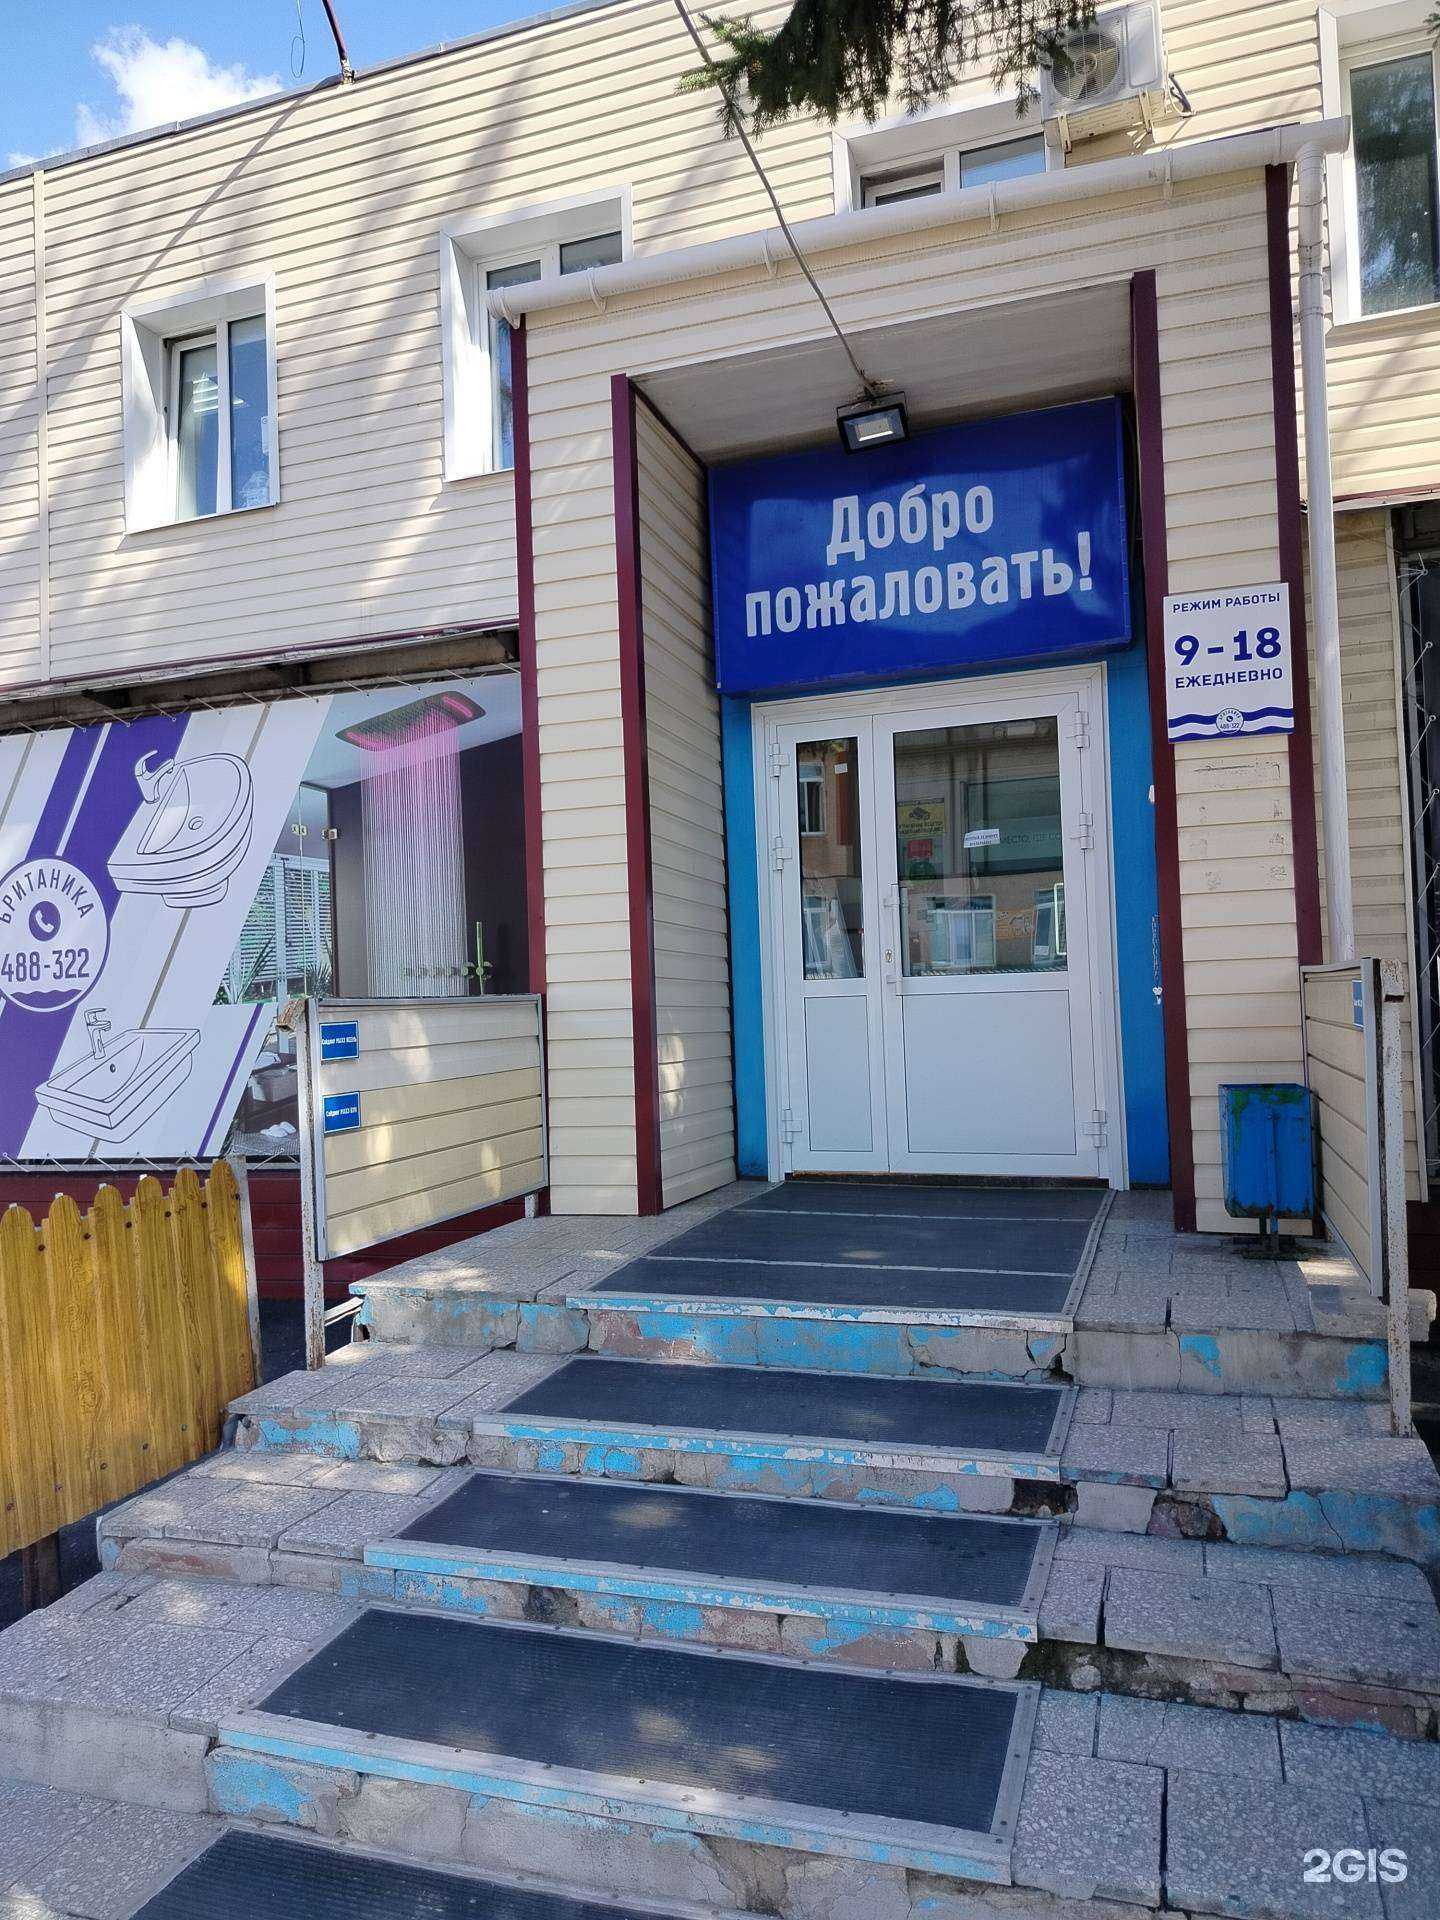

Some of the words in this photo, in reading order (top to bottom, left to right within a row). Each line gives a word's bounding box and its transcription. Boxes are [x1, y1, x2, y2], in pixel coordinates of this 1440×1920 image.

[826, 483, 994, 566] Добро
[745, 531, 1093, 637] пожаловать!
[1173, 599, 1221, 613] РЕЖИМ
[1226, 593, 1280, 607] РАБОТЫ
[1175, 668, 1283, 689] ЕЖЕДНЕВНО
[0, 868, 94, 924] БРИТАНИКА
[1, 948, 90, 982] 488-322
